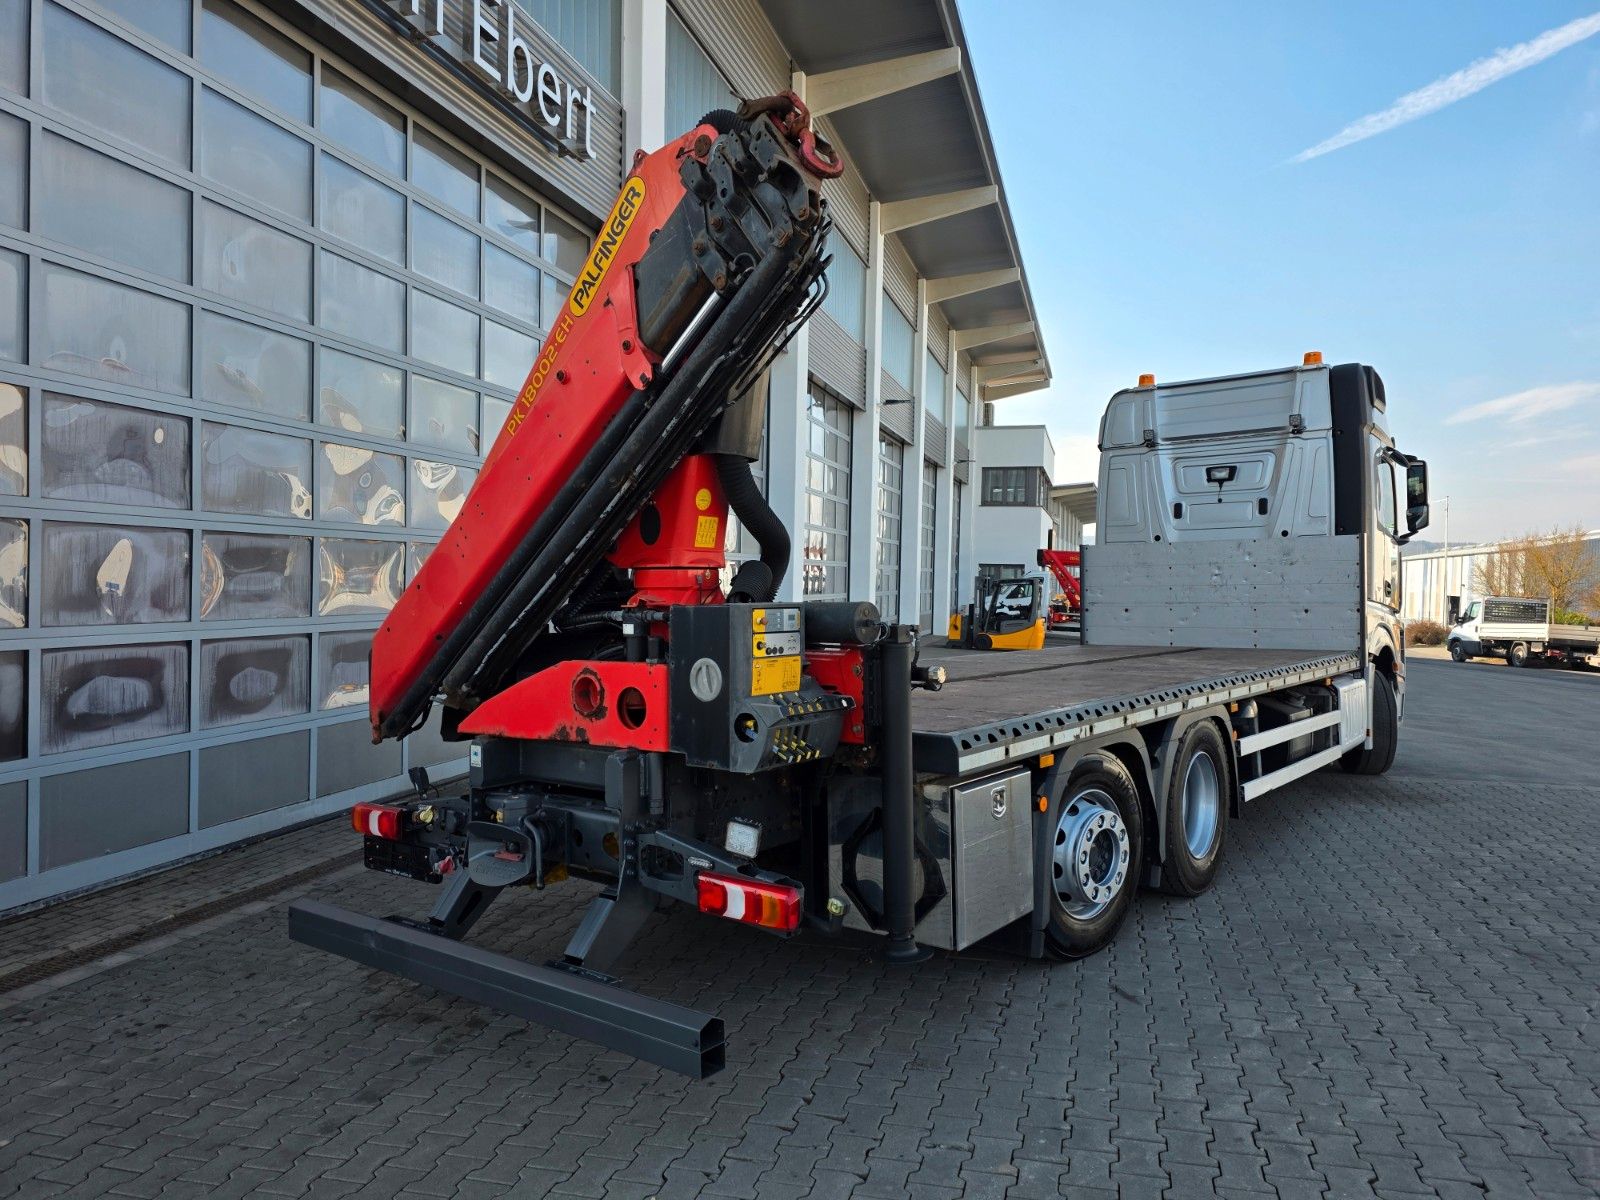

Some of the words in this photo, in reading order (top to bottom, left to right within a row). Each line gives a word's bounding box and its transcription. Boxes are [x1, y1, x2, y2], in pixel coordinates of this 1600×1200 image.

[474, 0, 597, 160] Ebert
[572, 185, 642, 309] PALFINGER
[507, 408, 526, 437] PK
